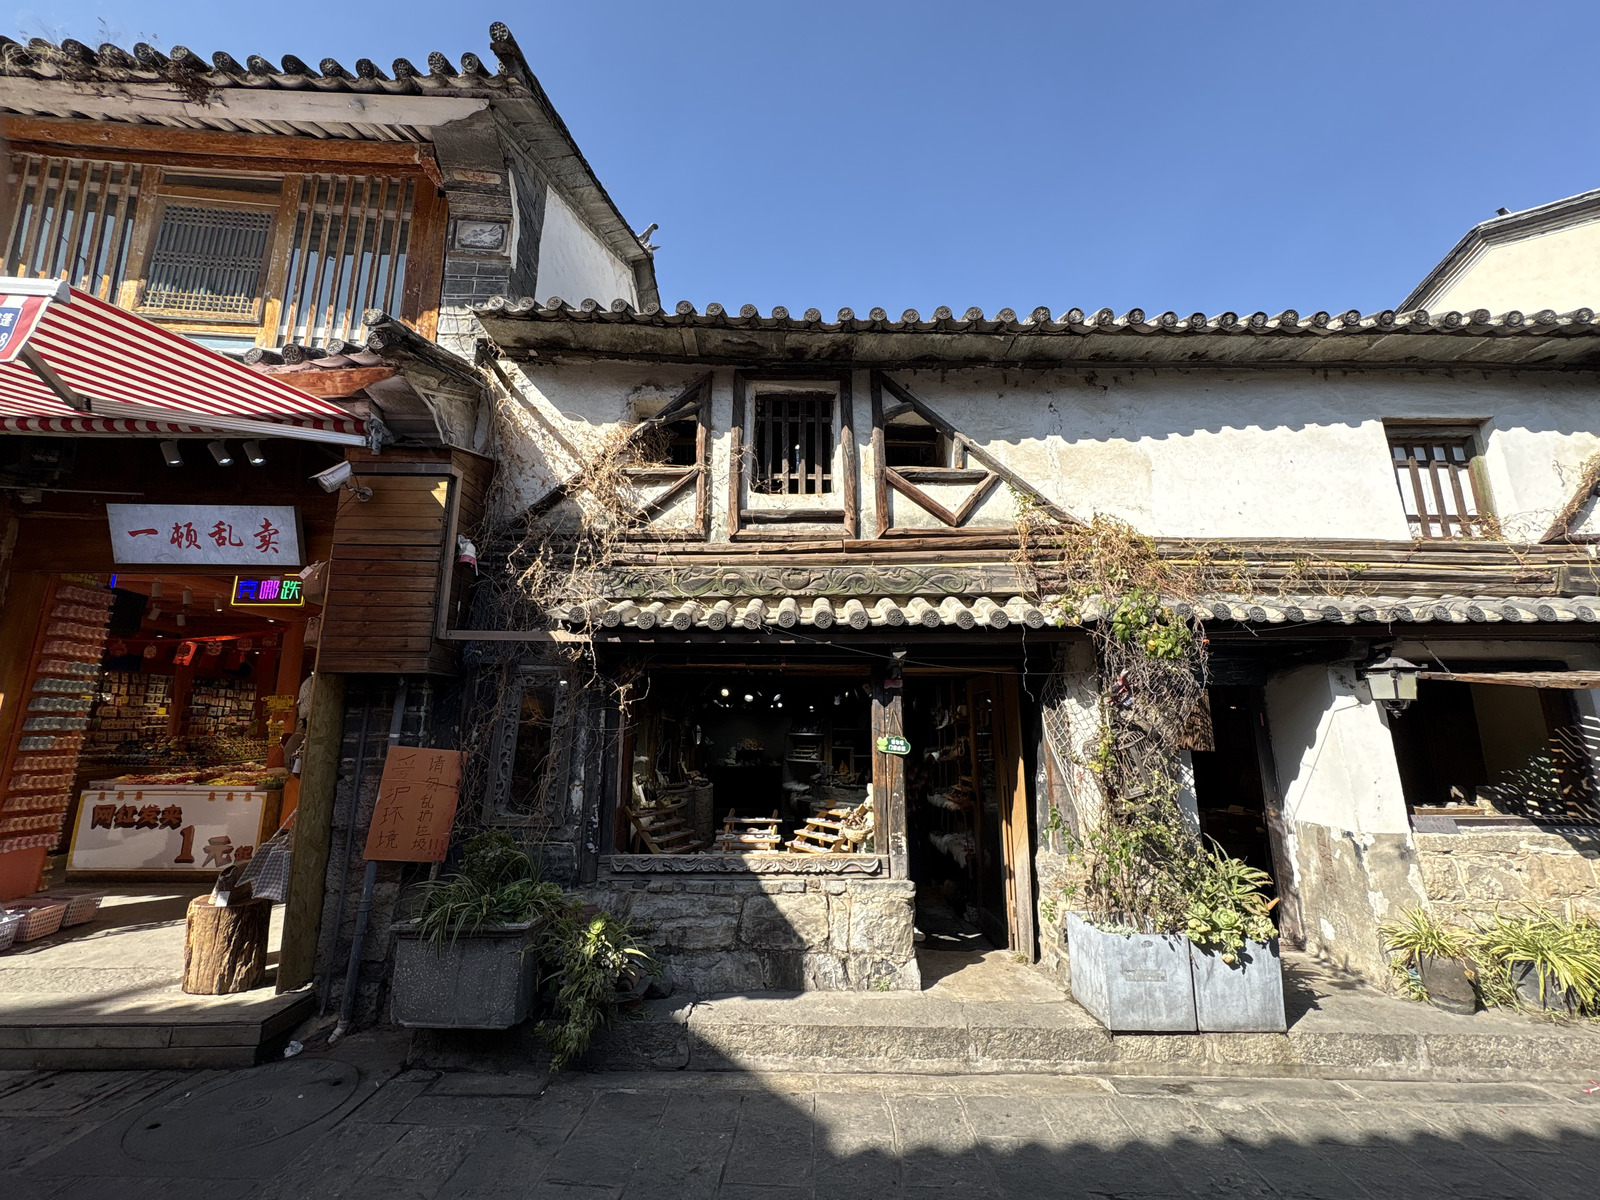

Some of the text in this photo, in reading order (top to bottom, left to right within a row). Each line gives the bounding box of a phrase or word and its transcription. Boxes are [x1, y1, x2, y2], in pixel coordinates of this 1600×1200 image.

[128, 517, 280, 554] 一顿乱卖
[91, 803, 183, 830] 网红发夹
[375, 753, 417, 849] 爱护环境
